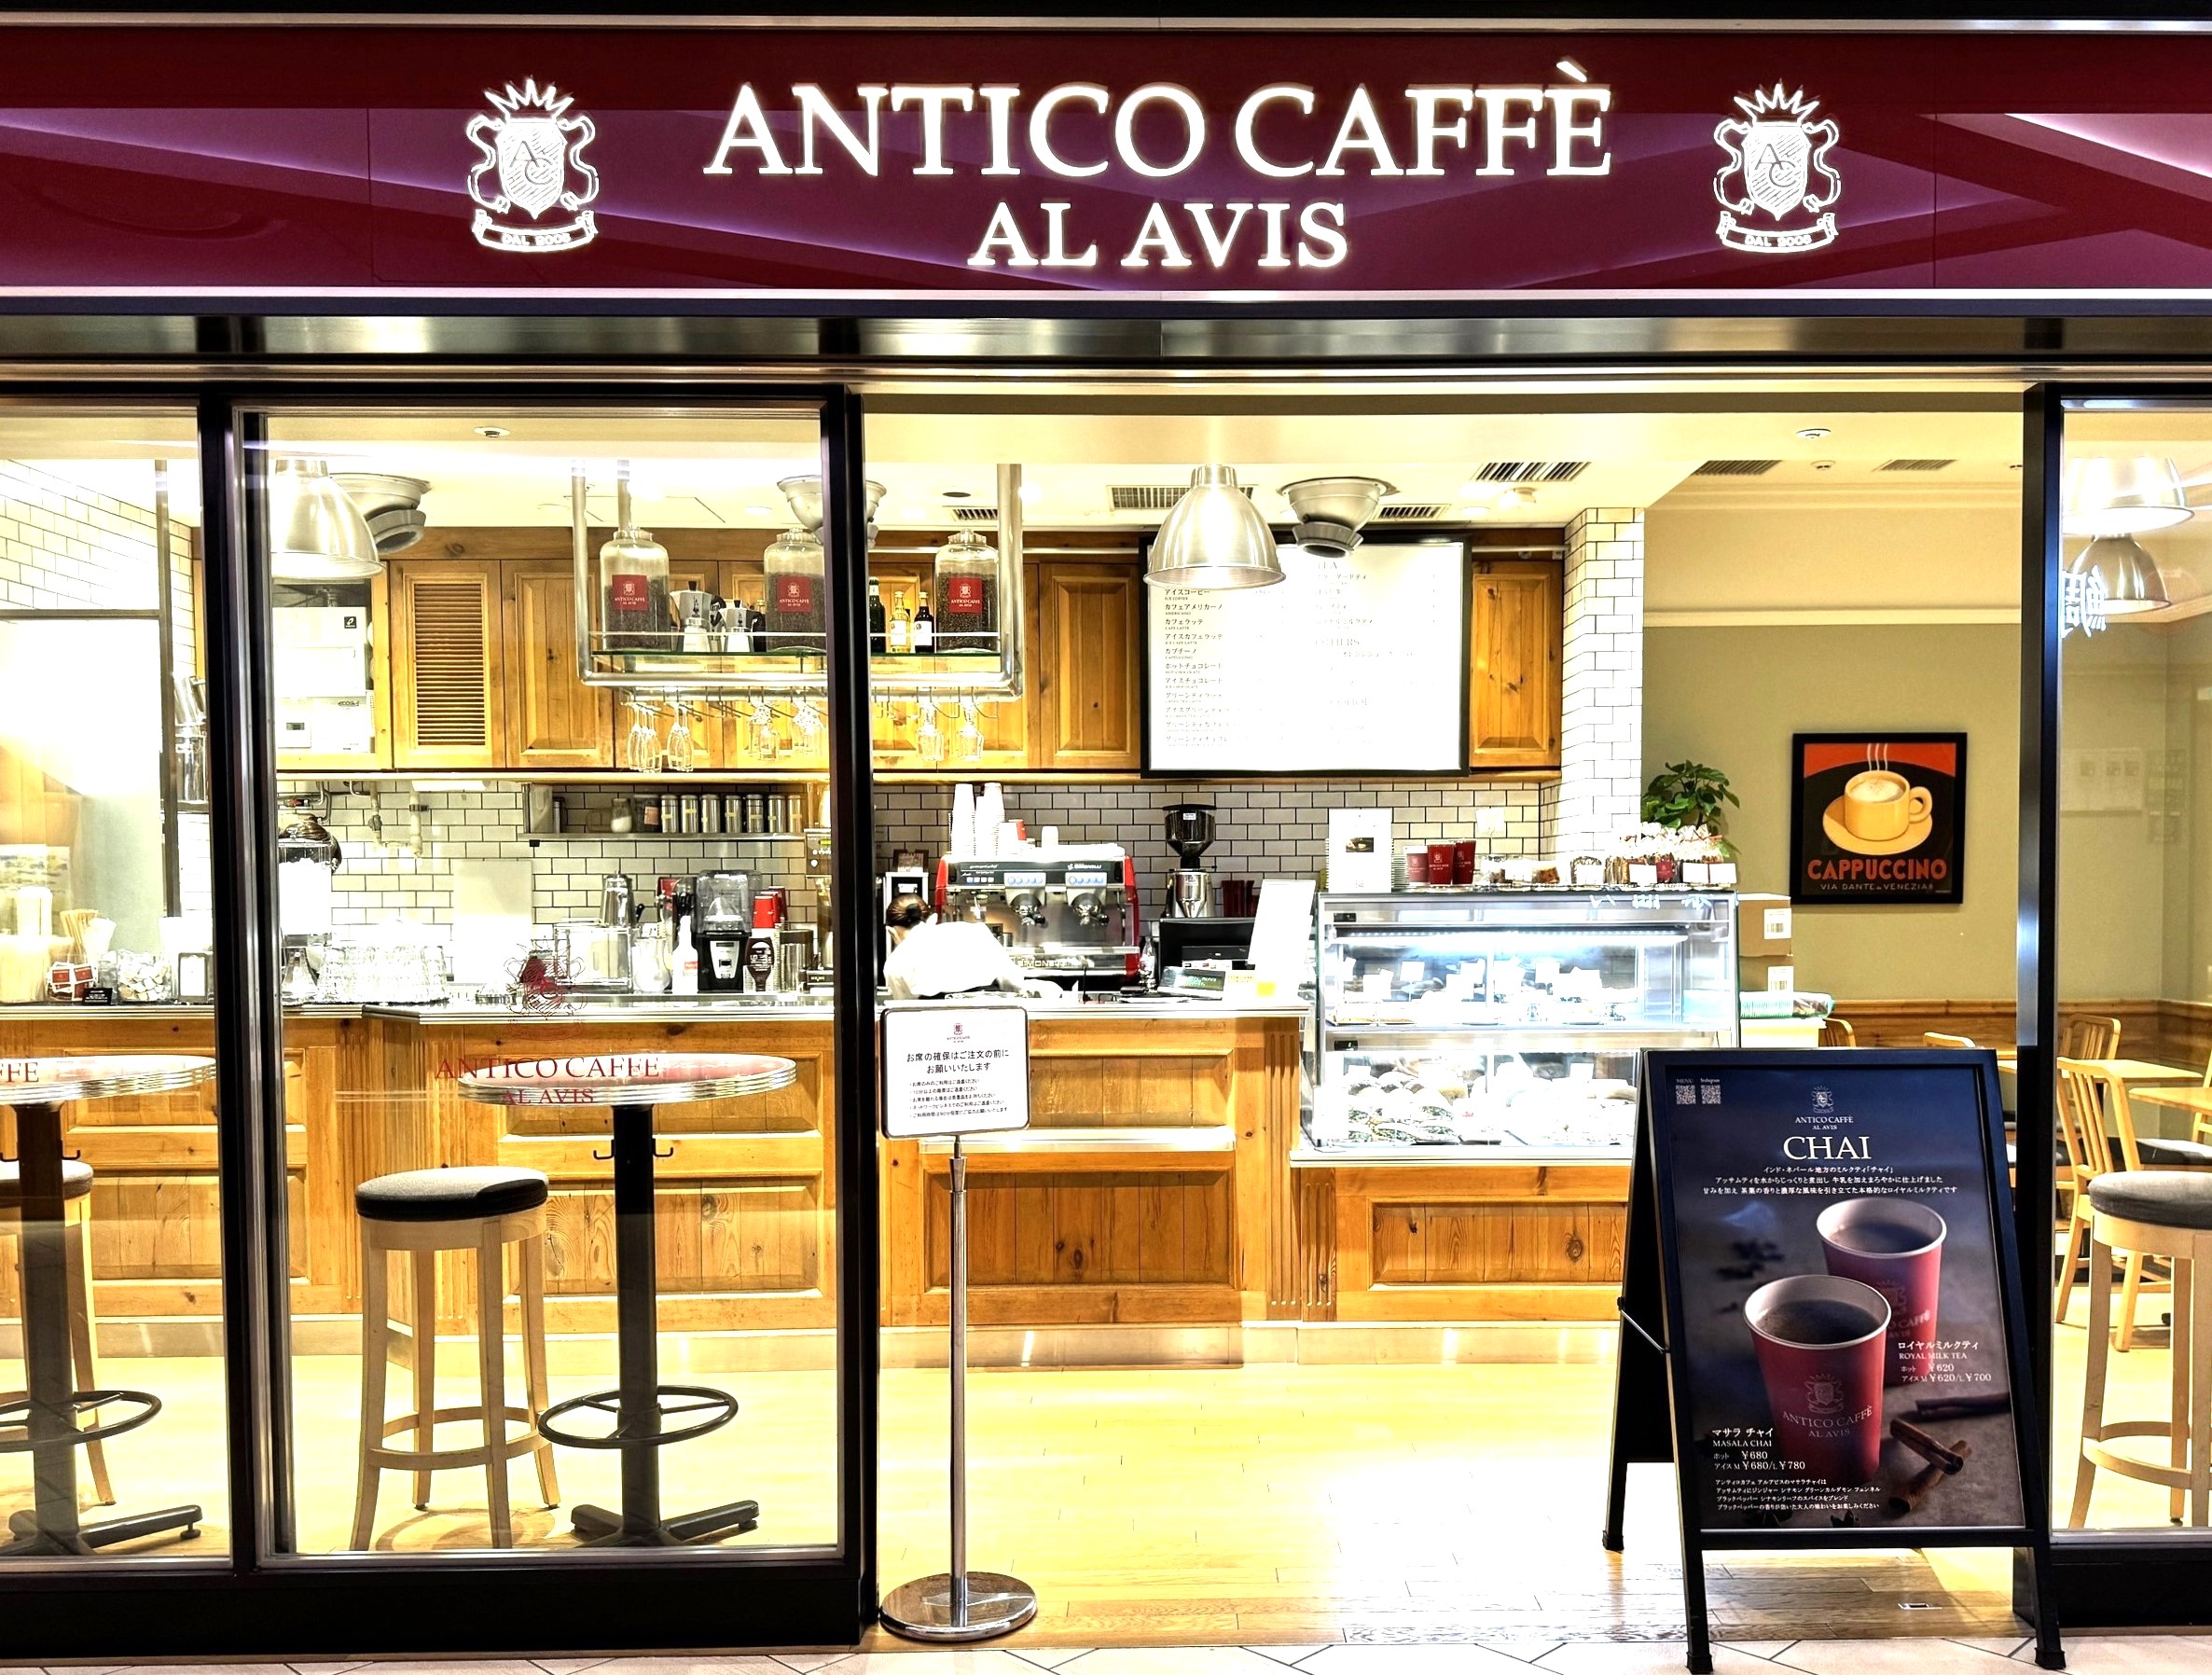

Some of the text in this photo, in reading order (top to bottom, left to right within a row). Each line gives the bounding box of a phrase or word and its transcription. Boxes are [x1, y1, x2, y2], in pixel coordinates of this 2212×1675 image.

[703, 62, 1611, 176] ANTICO CAFFÈ
[968, 202, 1347, 267] AL AVIS
[1807, 858, 1947, 880] CAPPUCCINO
[906, 1049, 1009, 1062] お席の確保はご注文の前に
[435, 1055, 558, 1079] ANTICO
[927, 1062, 990, 1073] お願いいたします
[502, 1088, 594, 1104] AL AVIS
[1783, 1136, 1872, 1160] CHAI
[1898, 1340, 1979, 1350] ロイヤルミルクティ
[1929, 1364, 1955, 1372] ¥620
[1783, 1410, 1833, 1428] ANTICO
[1711, 1428, 1774, 1437] マサラ チャイ
[1808, 1430, 1823, 1438] AL
[1741, 1450, 1768, 1460] ¥680
